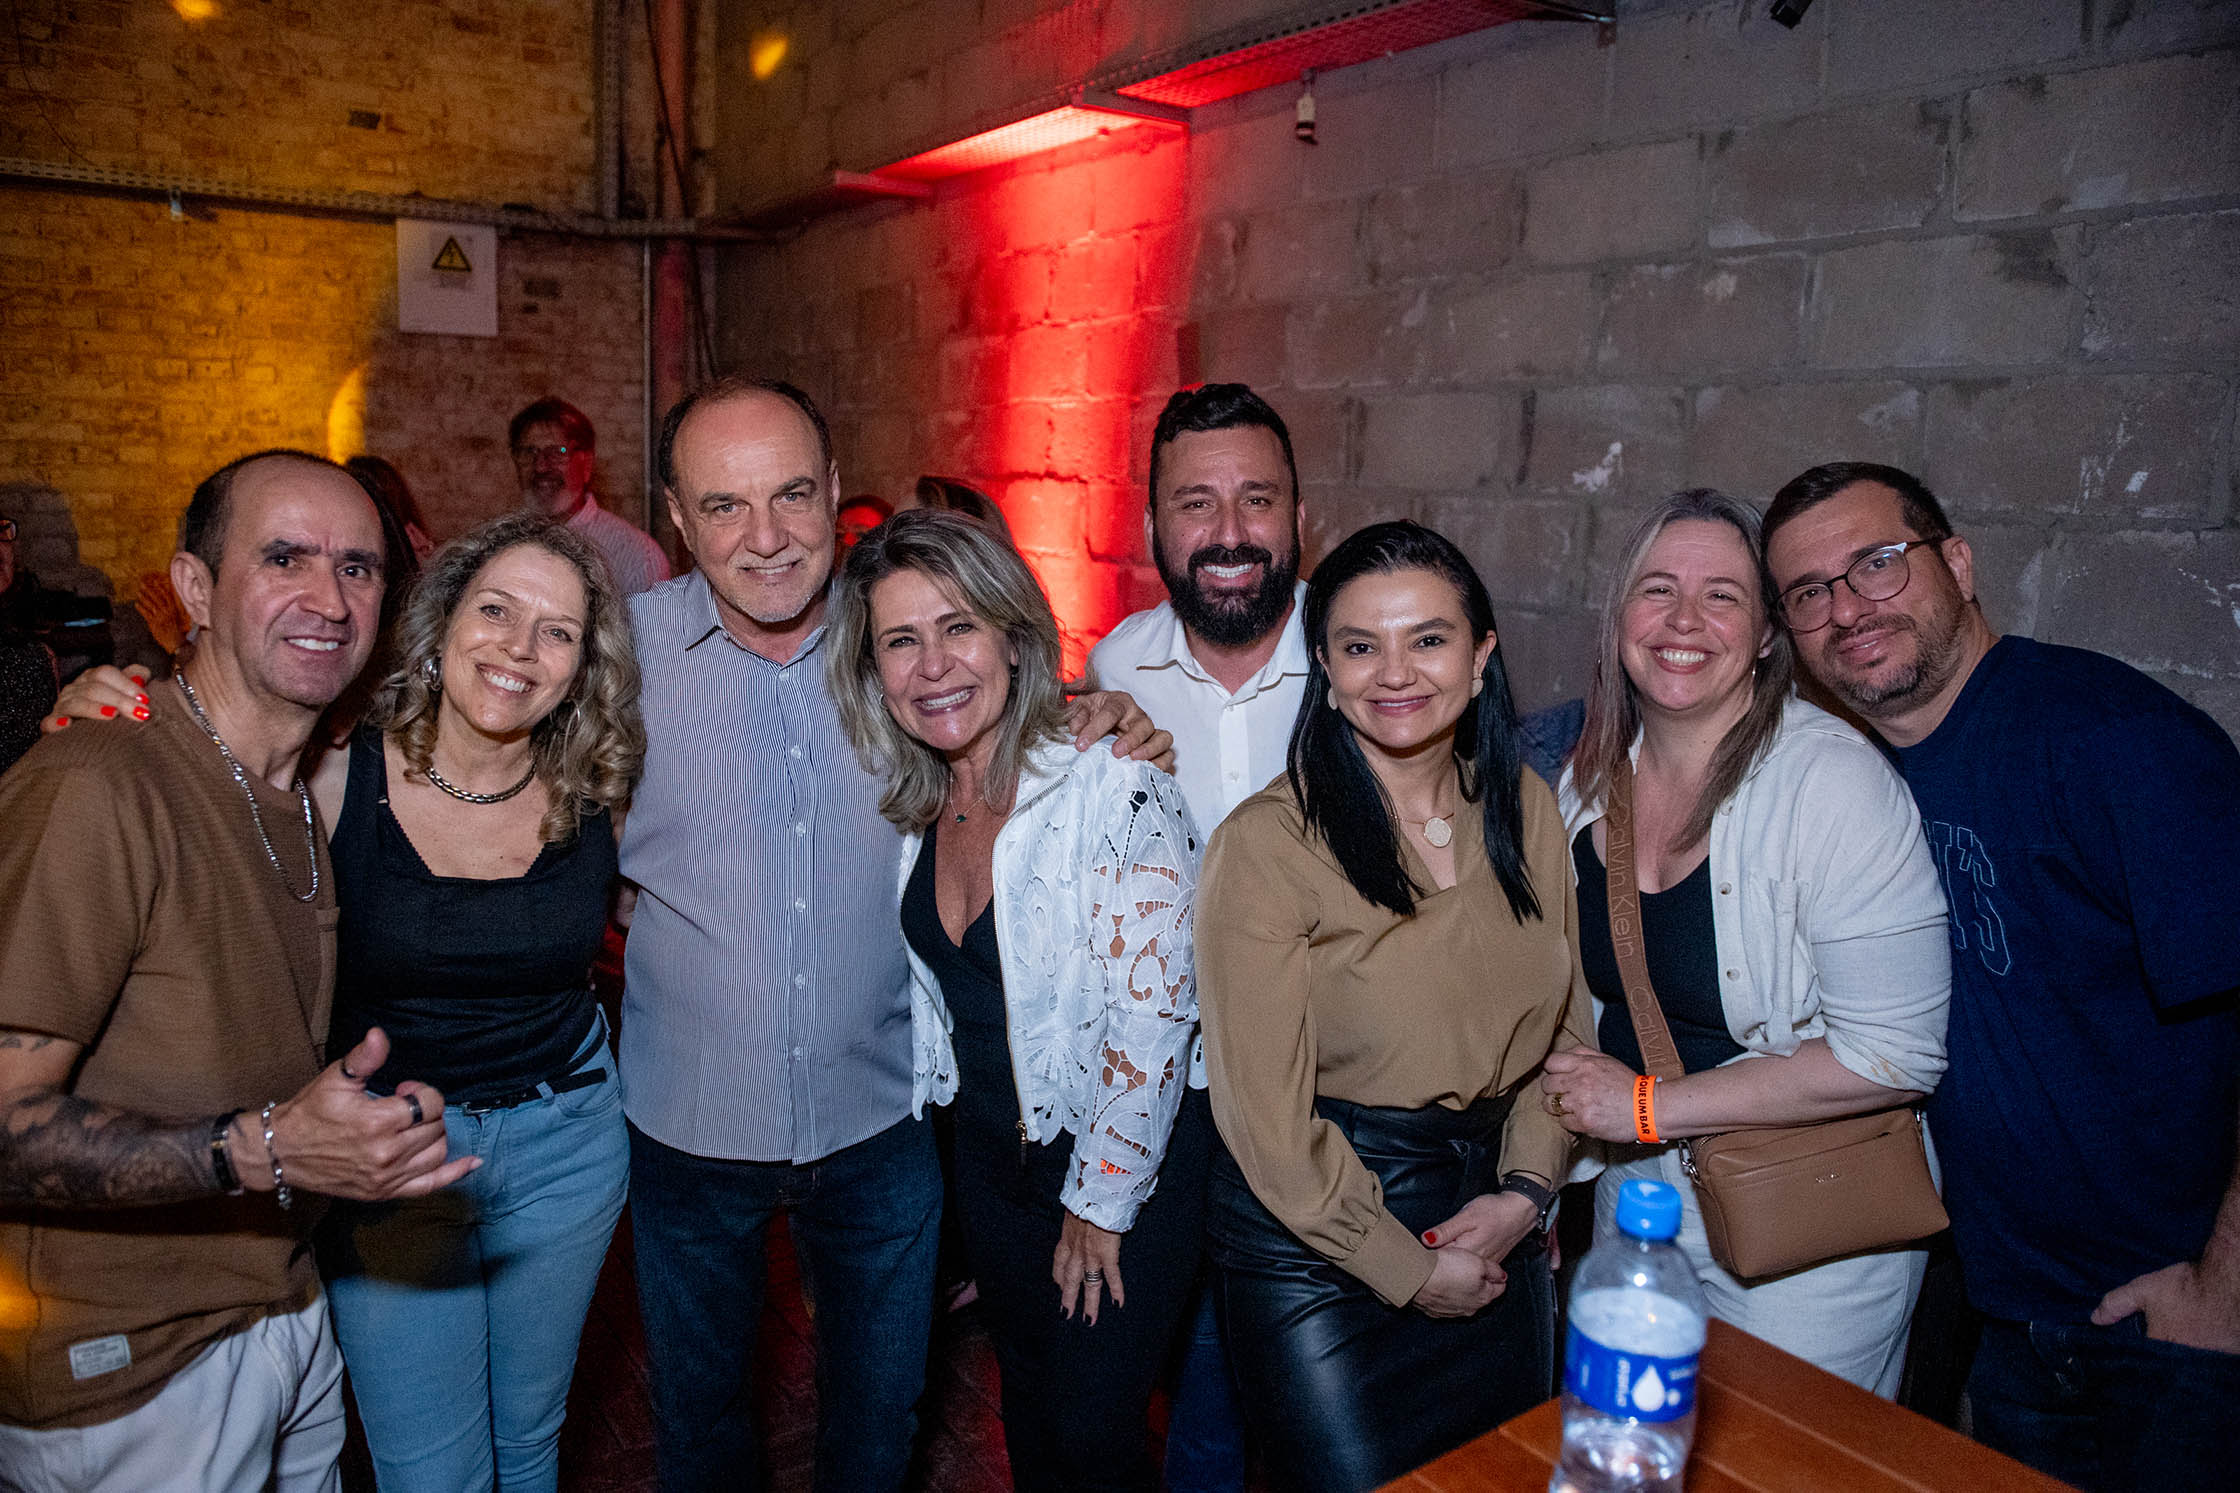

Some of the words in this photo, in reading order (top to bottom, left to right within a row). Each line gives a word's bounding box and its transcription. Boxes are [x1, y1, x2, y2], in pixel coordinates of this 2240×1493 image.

[1611, 893, 1637, 959] Klein
[1638, 1099, 1647, 1114] UM
[1639, 1115, 1650, 1134] BAR
